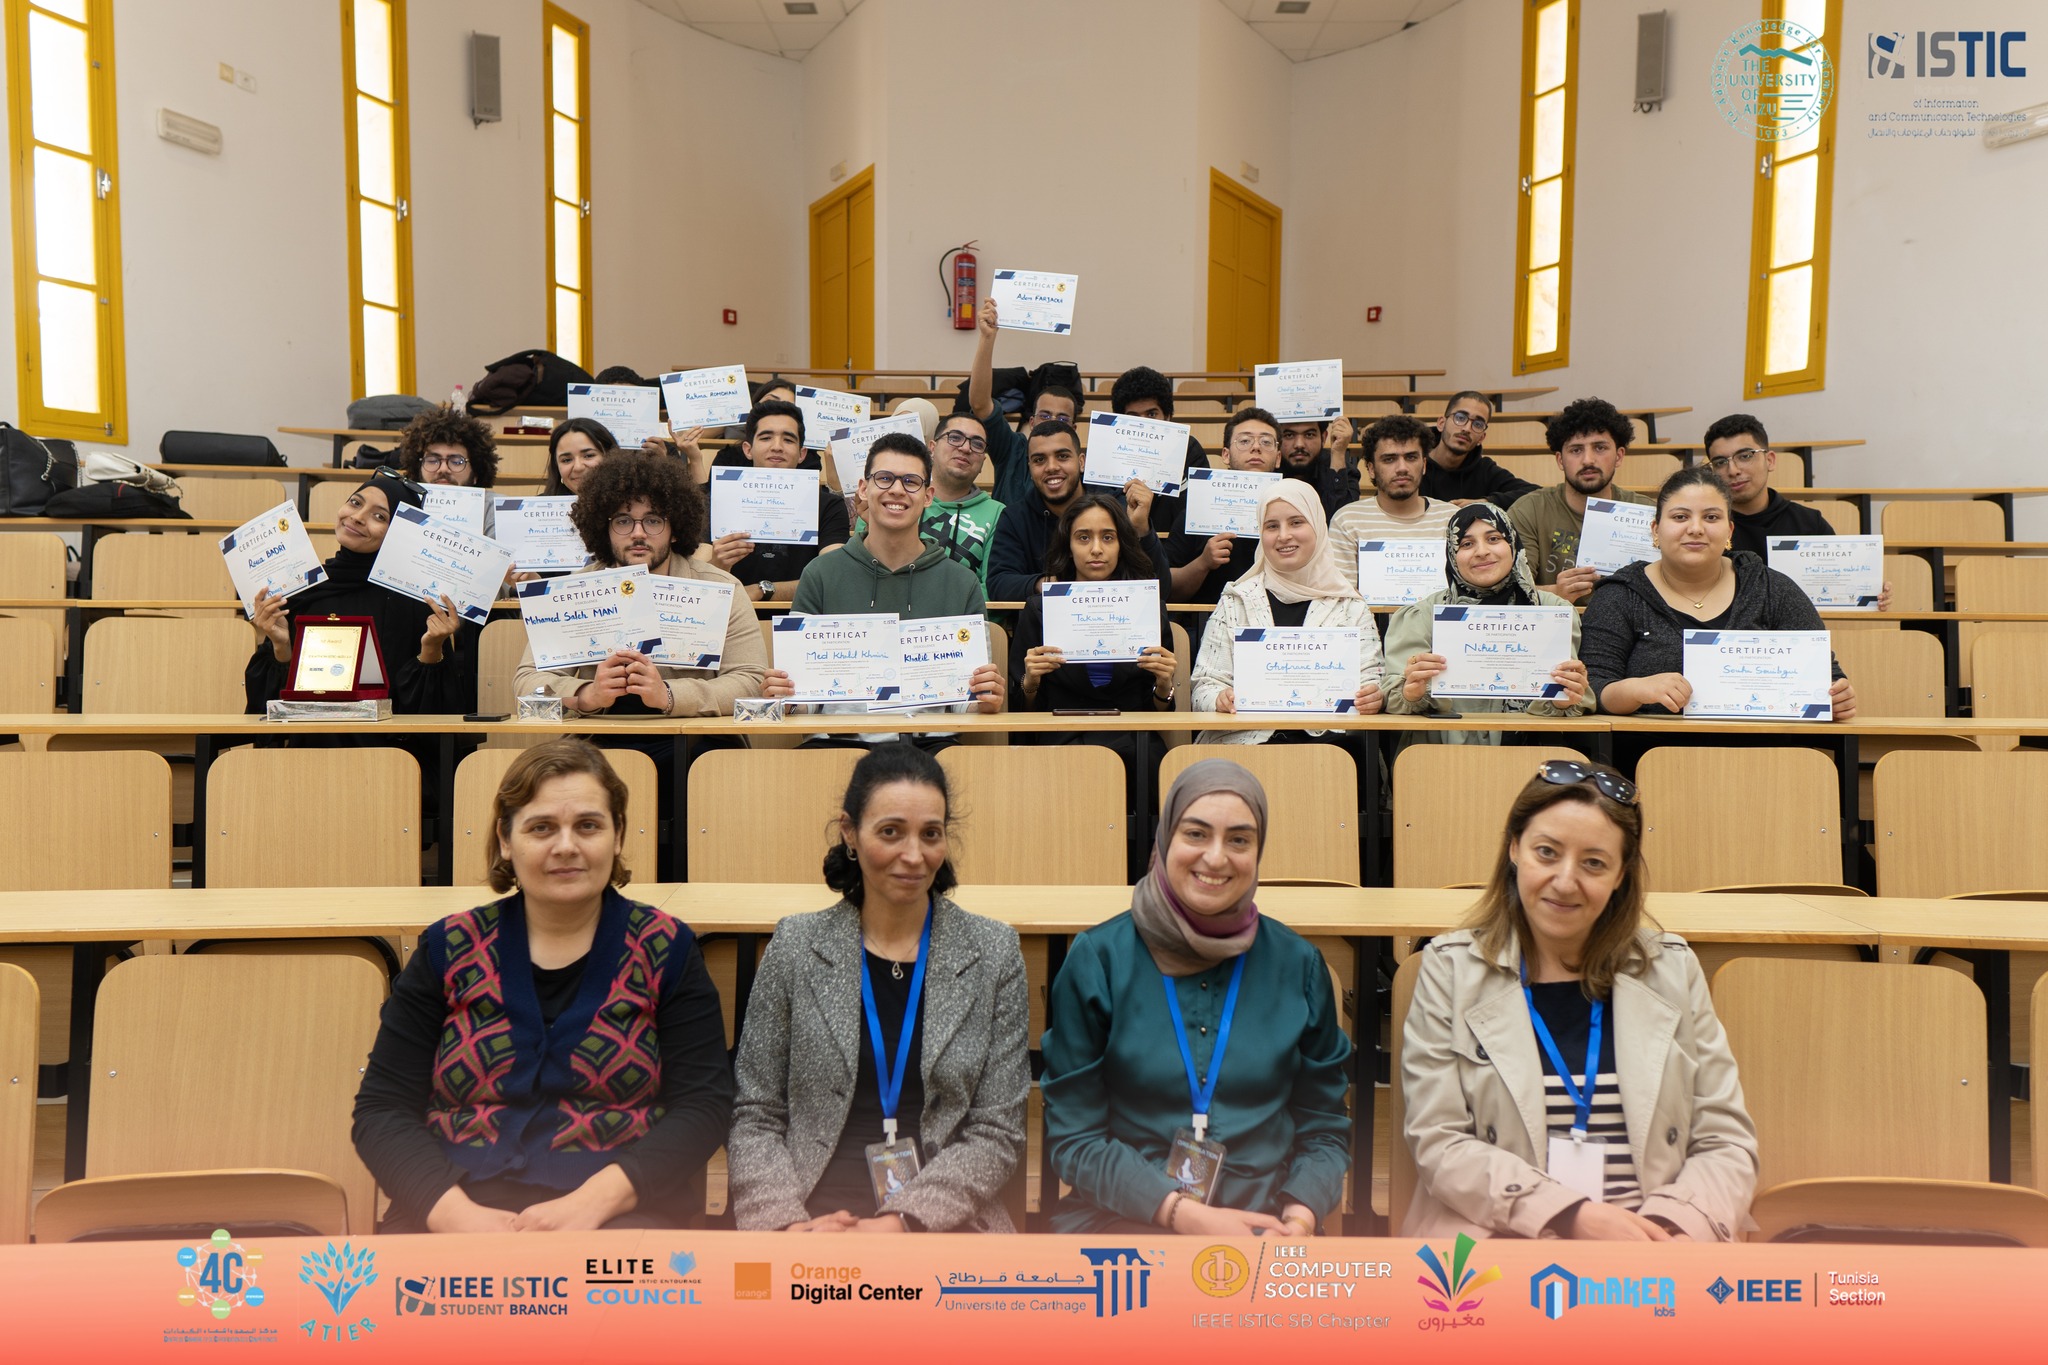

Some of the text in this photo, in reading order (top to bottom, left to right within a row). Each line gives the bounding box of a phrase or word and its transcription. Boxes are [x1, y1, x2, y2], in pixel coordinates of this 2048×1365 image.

[1013, 281, 1055, 289] CERTIFICAT
[684, 378, 726, 387] CERTIFICAT
[591, 396, 636, 404] CERTIFICAT
[816, 400, 853, 410] CERTIFICAT
[1115, 428, 1165, 441] CERTIFICAT
[743, 482, 795, 490] CERTIFICAT
[1212, 481, 1258, 490] CERTIFICAT
[238, 526, 278, 552] CERTIFICAT
[423, 530, 482, 557] CERTIFICAT
[552, 587, 618, 603] CERTIFICAT
[653, 593, 701, 604] RTIFICAT
[1072, 596, 1130, 604] CERTIFICAT
[1468, 623, 1537, 631] CERTIFICAT
[805, 631, 867, 639] CERTIFICAT
[900, 633, 954, 644] ERTIFICAT
